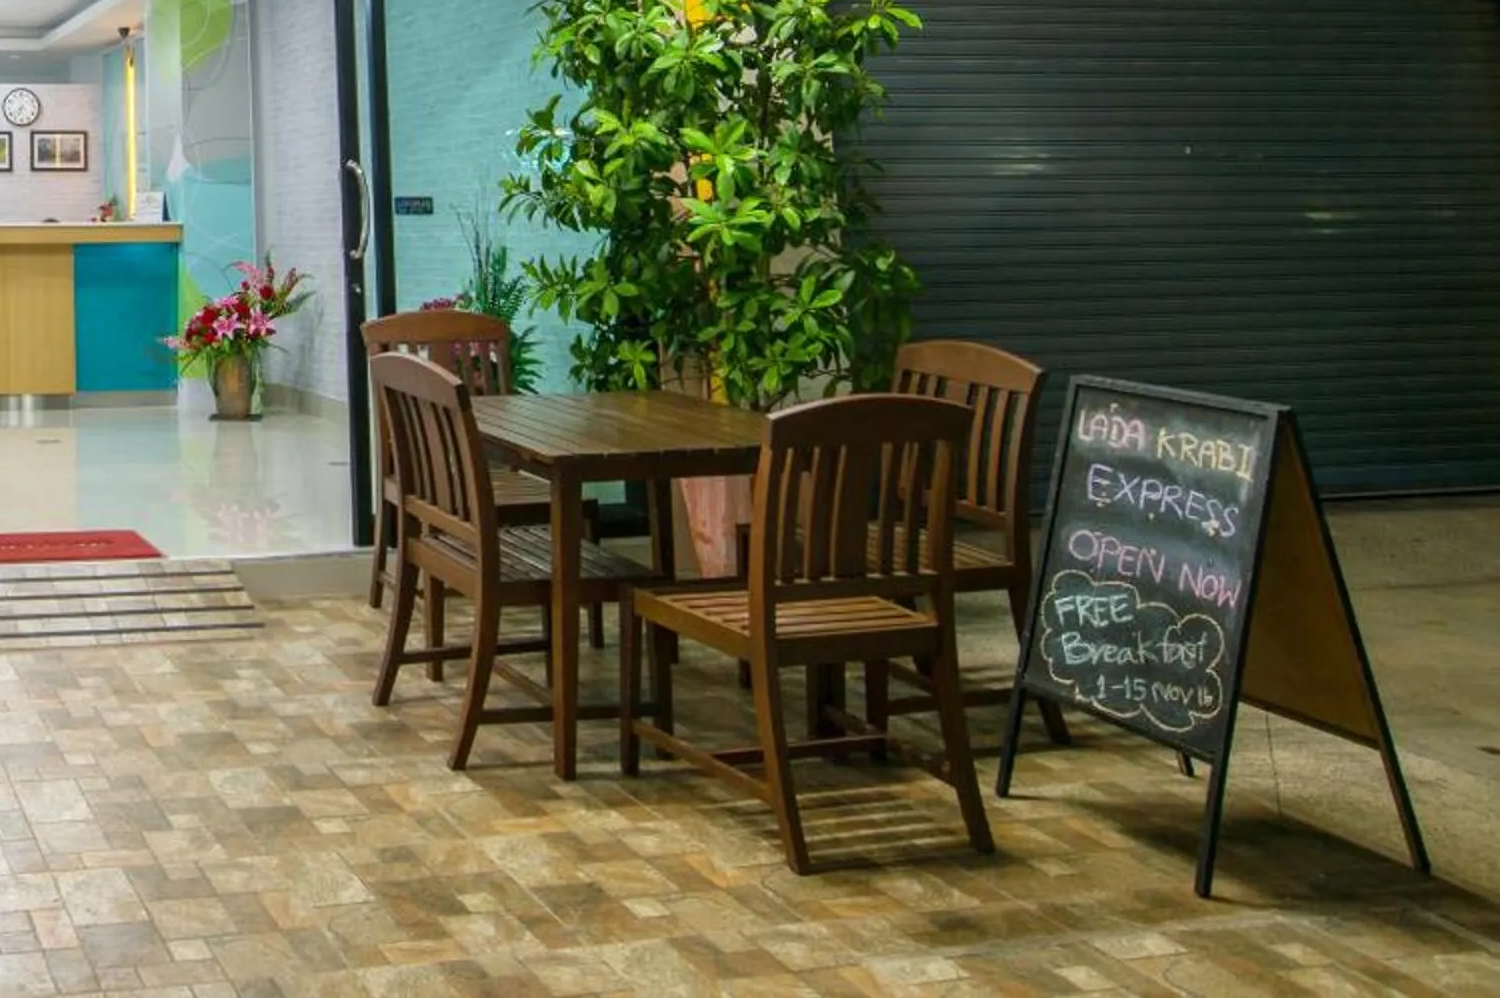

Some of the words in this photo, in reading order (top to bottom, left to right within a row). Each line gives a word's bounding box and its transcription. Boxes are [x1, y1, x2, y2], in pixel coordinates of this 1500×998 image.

[1078, 409, 1147, 451] LADA
[1156, 427, 1256, 484] KRABI
[1086, 462, 1239, 538] EXPRESS
[1068, 529, 1166, 584] OPEN
[1179, 562, 1243, 610] NOW
[1054, 593, 1134, 628] FREE
